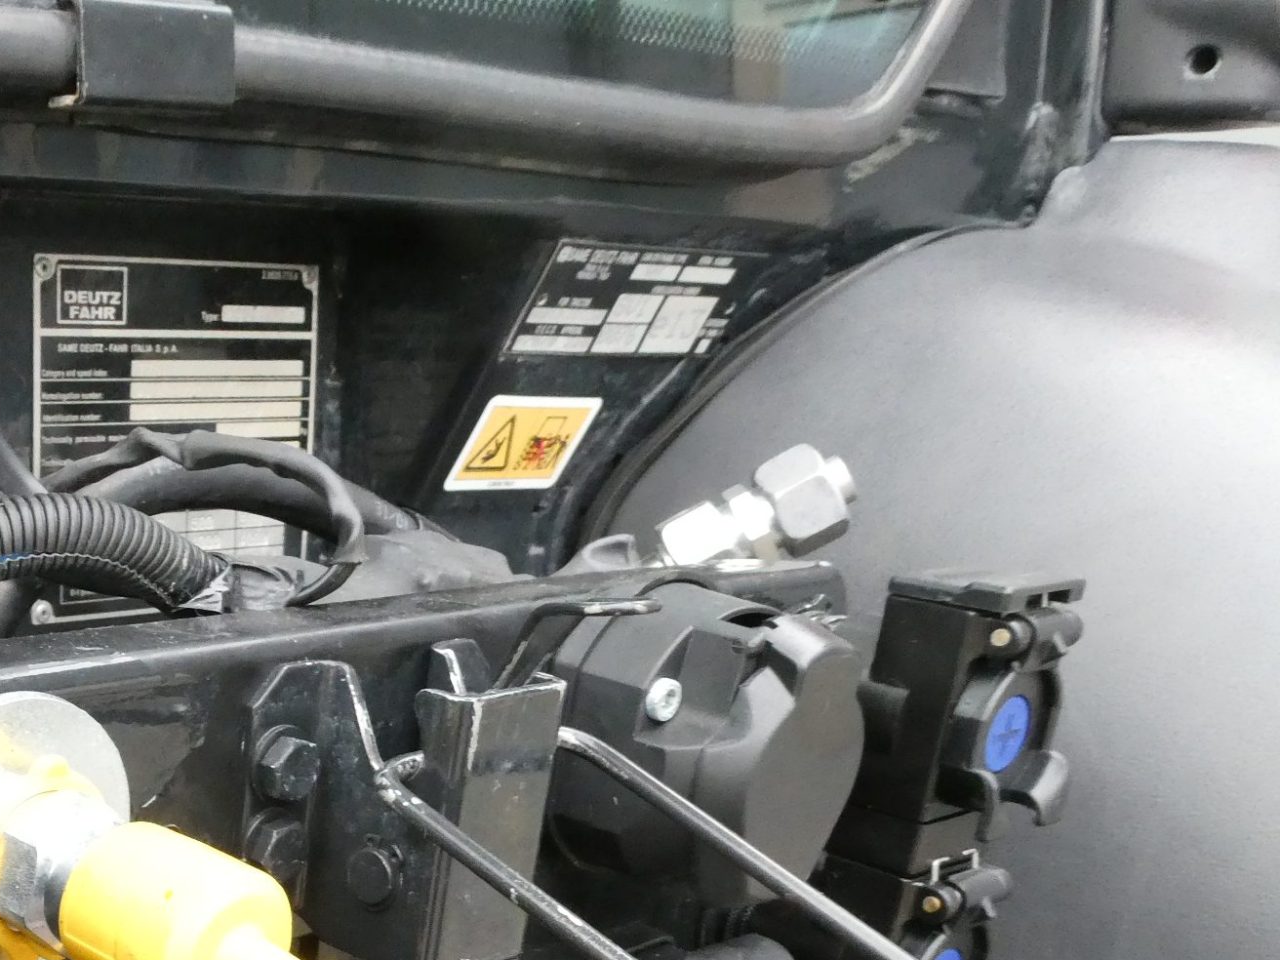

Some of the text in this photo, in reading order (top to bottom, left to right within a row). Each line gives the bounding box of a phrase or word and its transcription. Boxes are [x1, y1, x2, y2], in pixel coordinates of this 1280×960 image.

[63, 290, 122, 304] DEUTZ
[69, 306, 117, 320] FAHR
[79, 343, 105, 353] DEUTZ
[108, 343, 129, 353] FAHR
